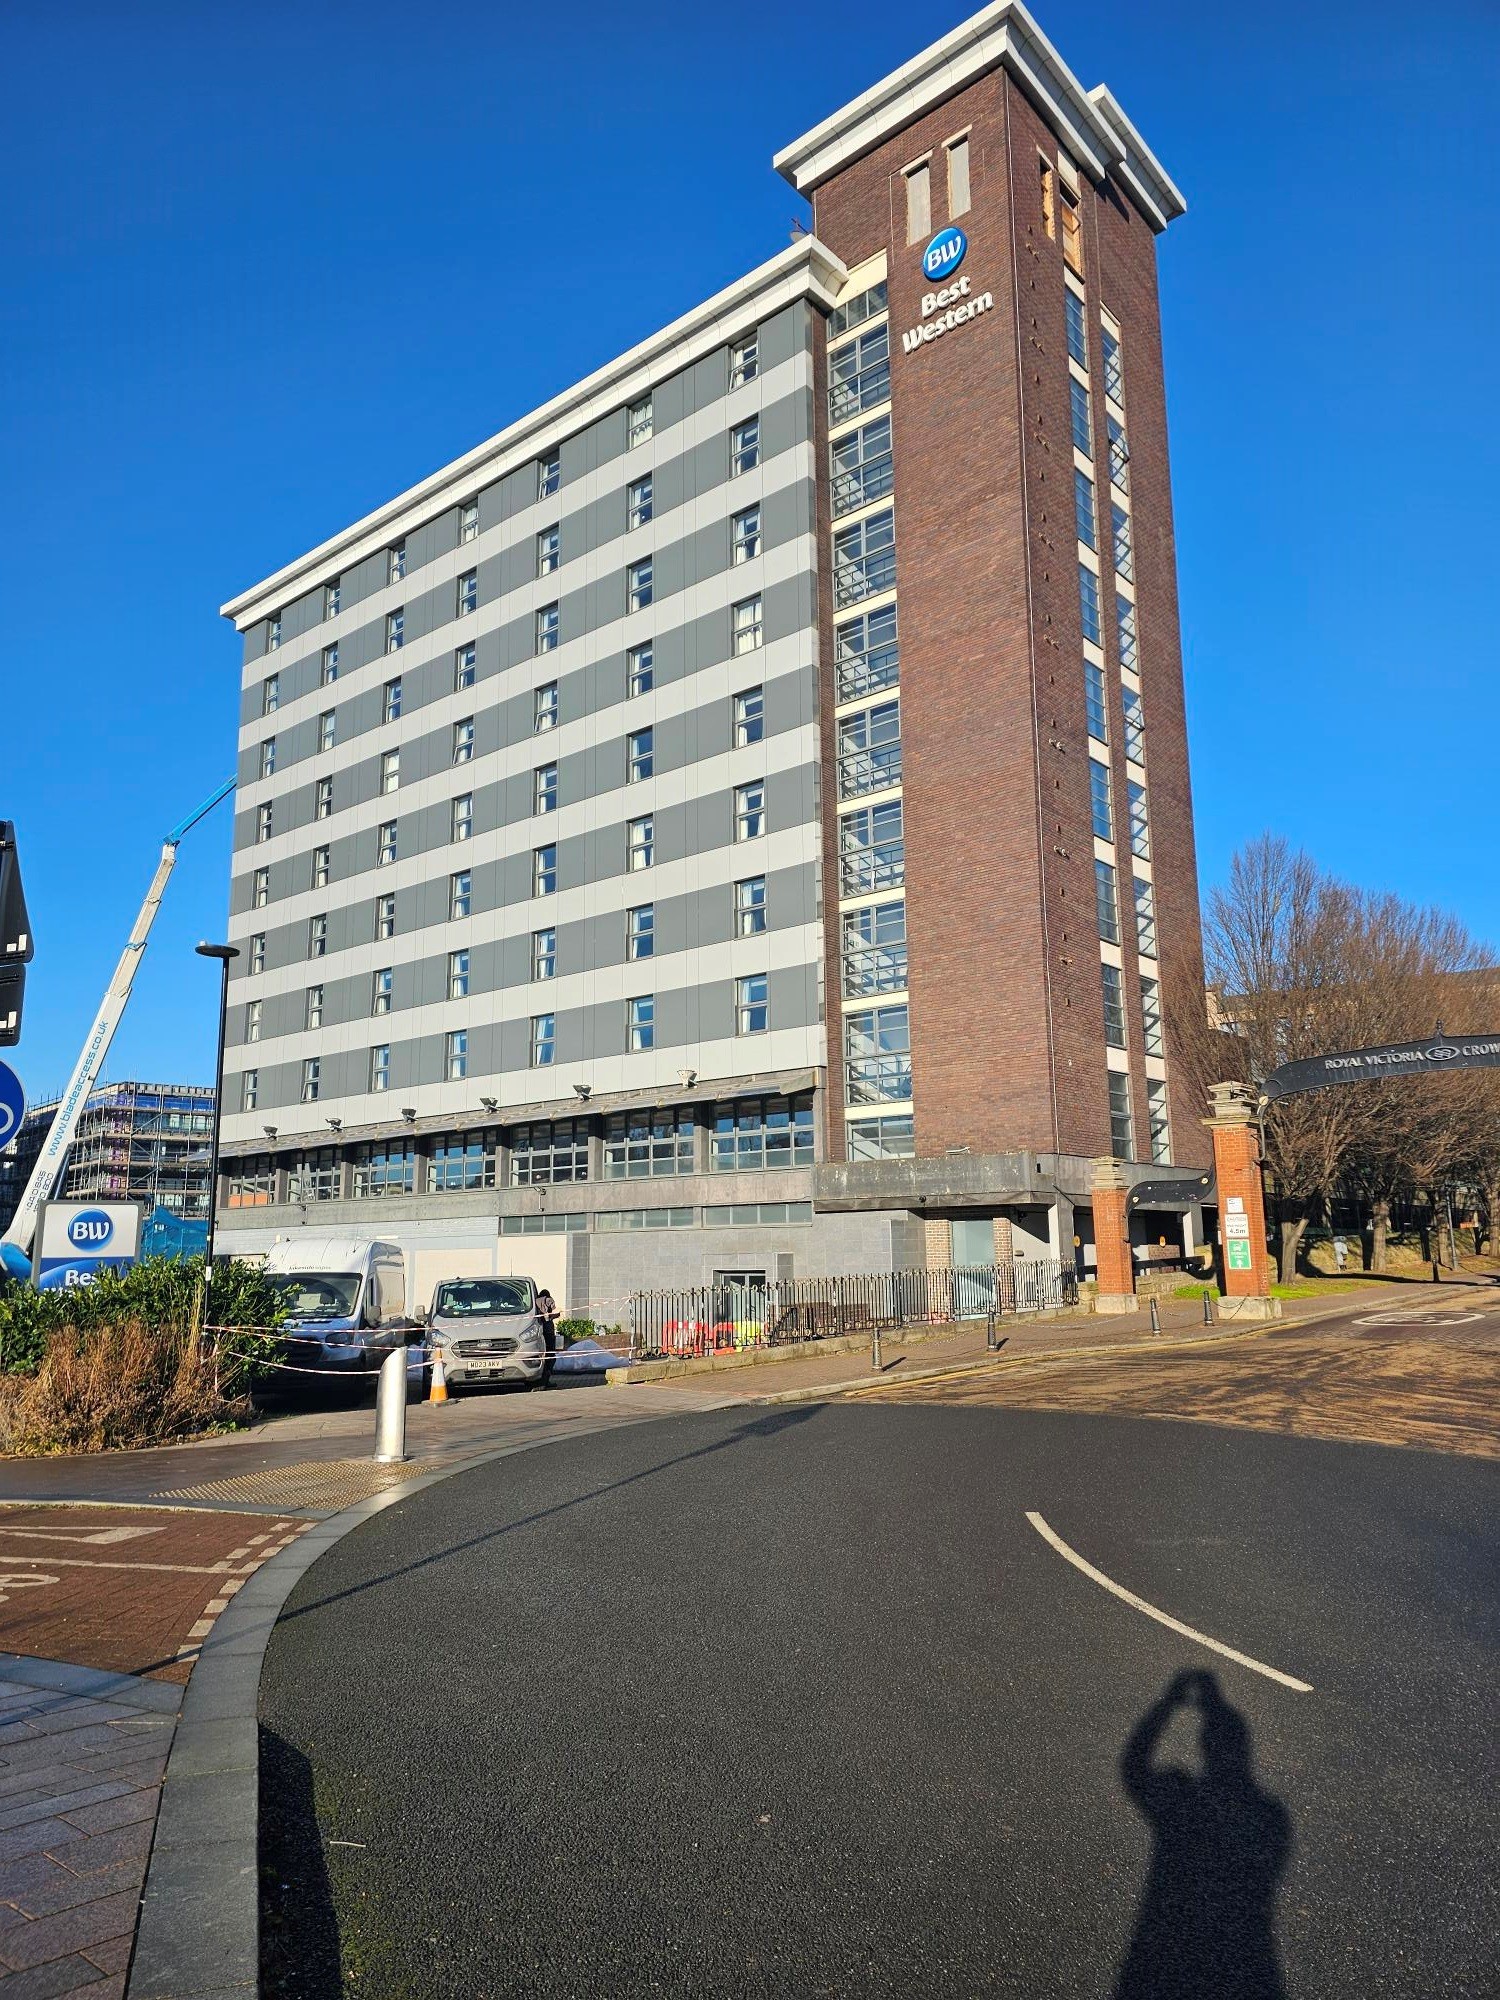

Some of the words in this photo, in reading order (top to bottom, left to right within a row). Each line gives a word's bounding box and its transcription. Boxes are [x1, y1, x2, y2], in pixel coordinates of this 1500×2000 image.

[927, 235, 962, 272] BW
[921, 275, 972, 317] Best
[902, 291, 995, 354] Western
[1324, 1057, 1364, 1070] ROYAL
[1365, 1050, 1426, 1065] VICTORIA
[47, 1020, 109, 1157] www.bladeaccess.co.uk
[71, 1221, 111, 1241] BW
[65, 1269, 98, 1287] Bes
